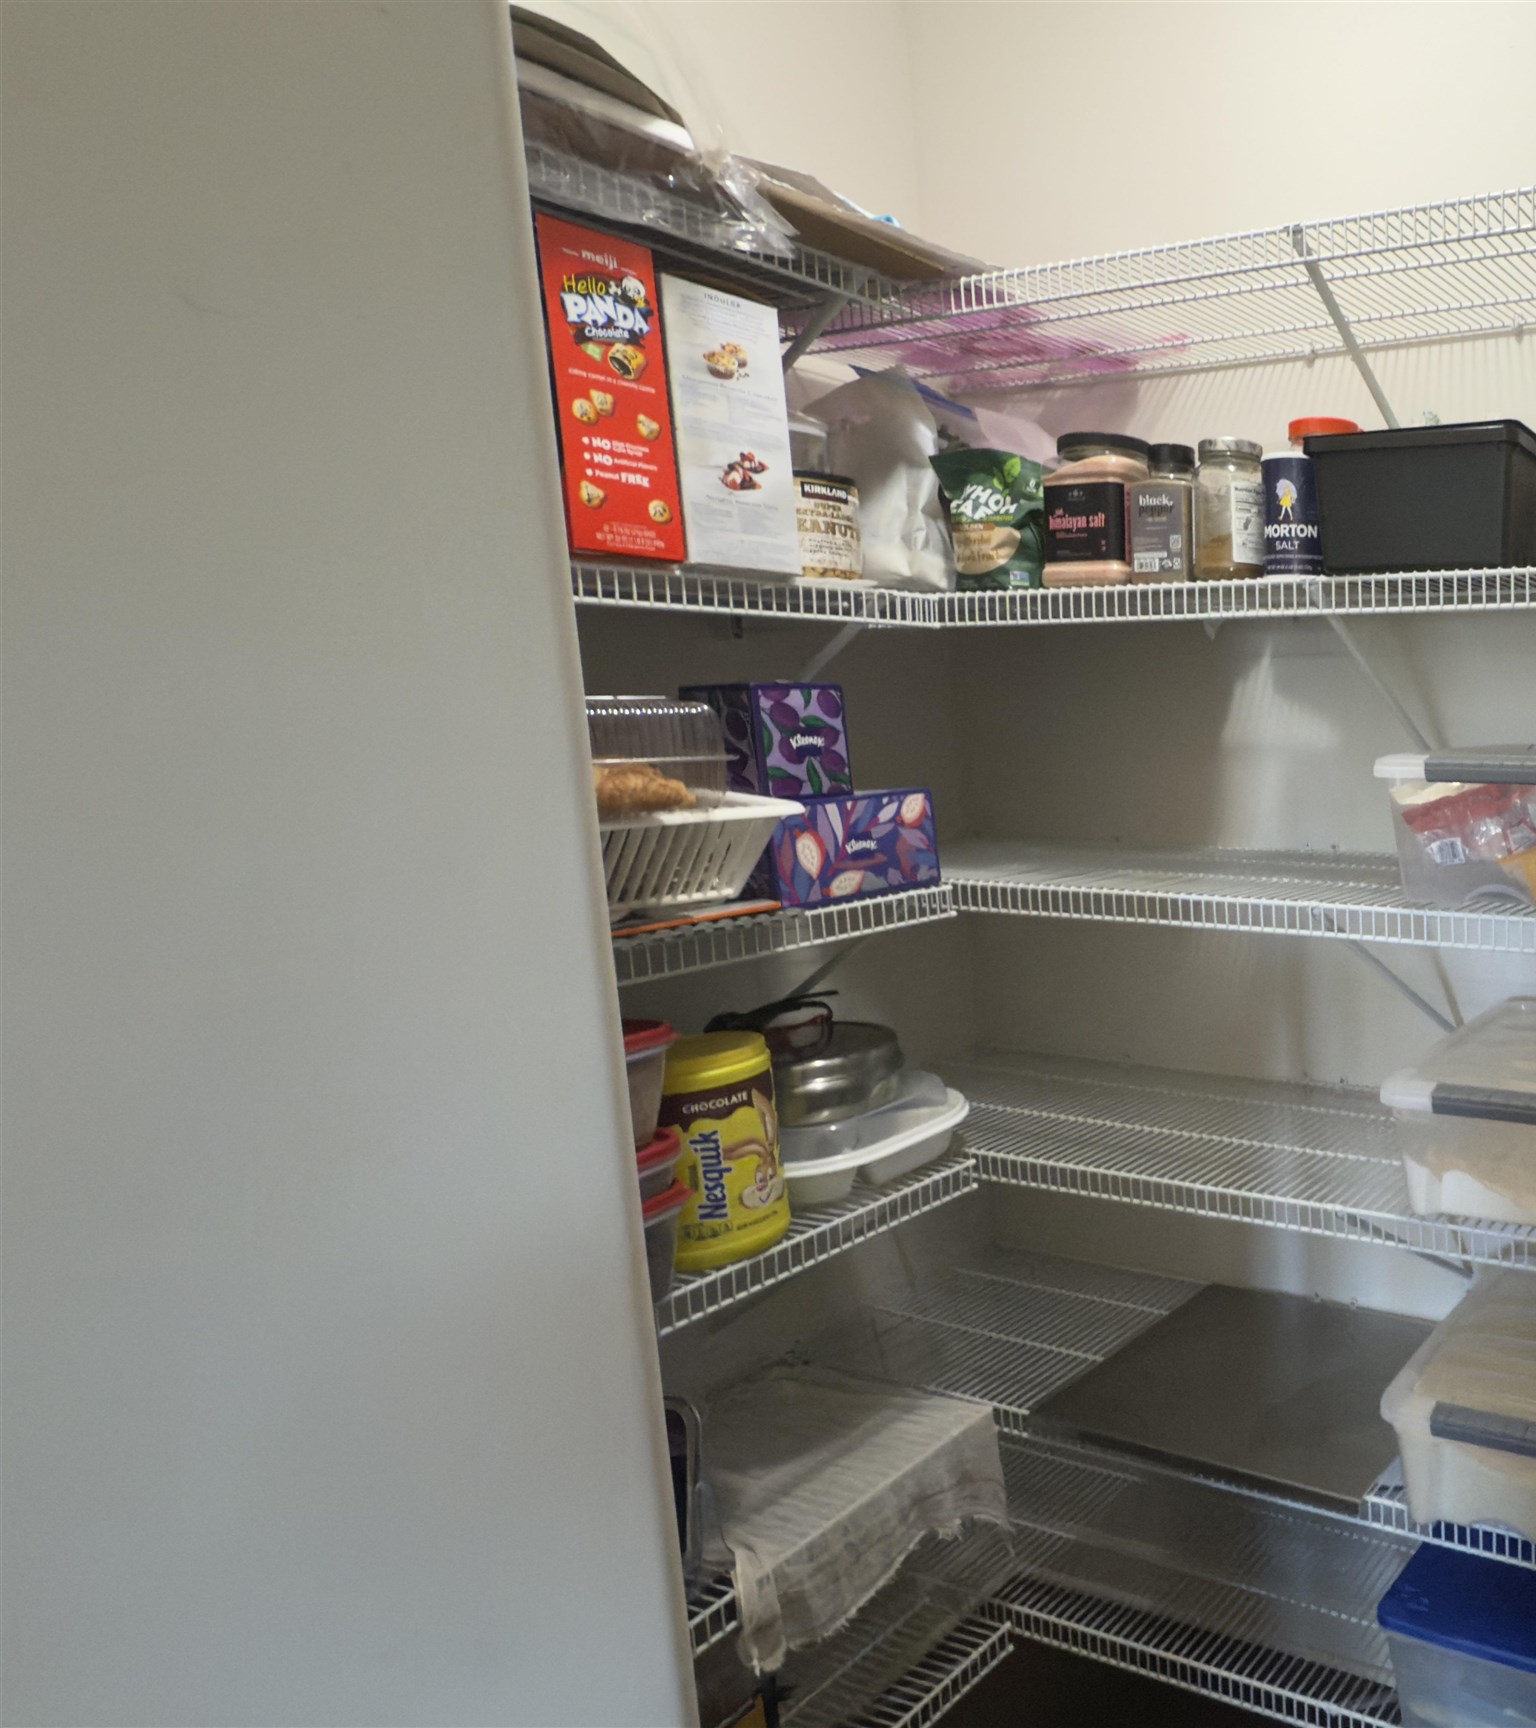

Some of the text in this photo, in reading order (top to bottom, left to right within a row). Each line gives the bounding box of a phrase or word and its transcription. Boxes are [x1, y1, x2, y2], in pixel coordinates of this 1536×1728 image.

[581, 249, 618, 271] meiji
[563, 273, 606, 296] Hello
[560, 291, 651, 335] PANDA
[584, 326, 629, 339] Chocolate
[591, 436, 611, 451] NO
[592, 452, 613, 467] NO
[803, 483, 848, 500] KIRKLAND
[1089, 511, 1105, 528] salt
[1264, 523, 1318, 539] MORTON
[1275, 540, 1299, 551] SALT
[682, 1090, 748, 1115] CHOCOLATE
[689, 1129, 732, 1220] Nesquik
